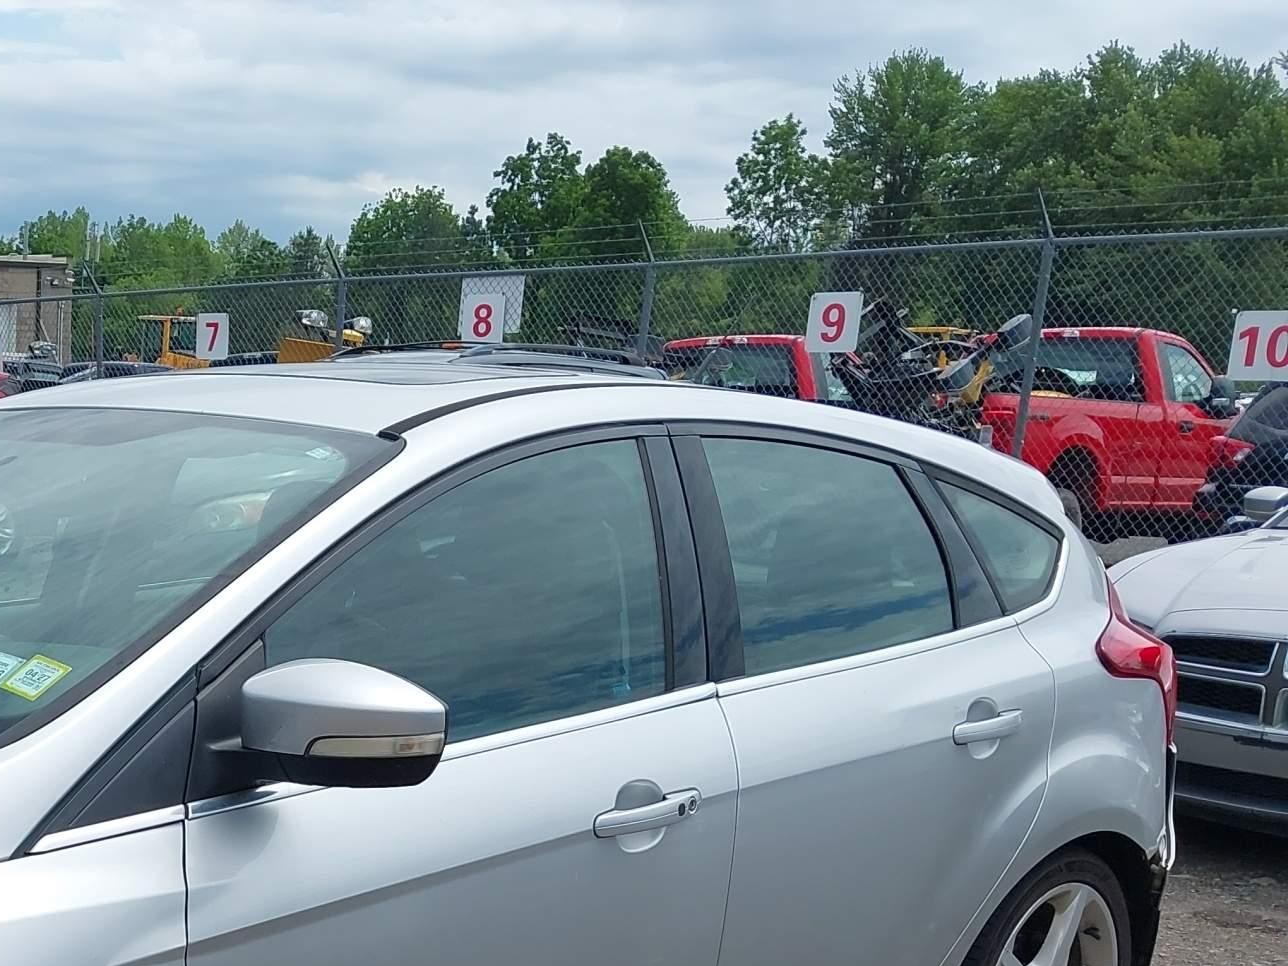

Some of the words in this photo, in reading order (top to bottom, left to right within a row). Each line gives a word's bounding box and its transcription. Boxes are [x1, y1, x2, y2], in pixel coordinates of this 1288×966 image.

[205, 321, 219, 352] 7
[472, 303, 493, 338] 8
[820, 302, 846, 343] 9
[1238, 324, 1288, 368] 10
